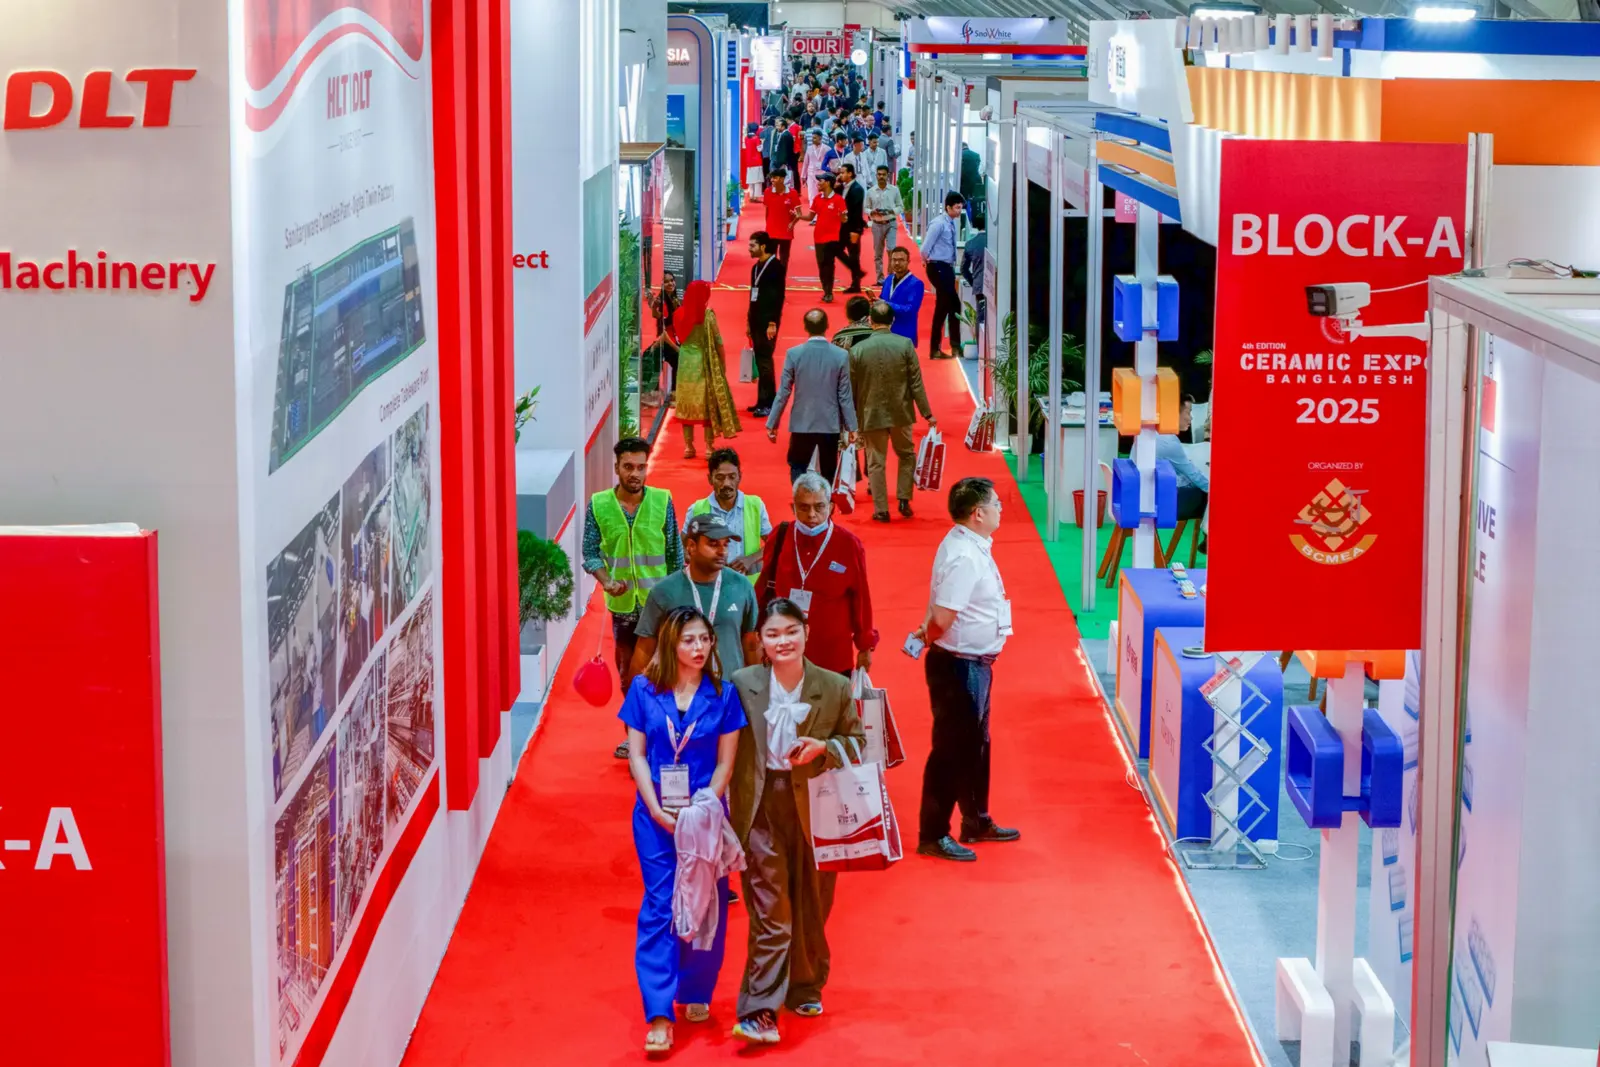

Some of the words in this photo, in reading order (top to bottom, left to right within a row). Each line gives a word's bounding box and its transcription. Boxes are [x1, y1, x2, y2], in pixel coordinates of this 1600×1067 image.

[667, 48, 690, 61] SIA
[794, 40, 838, 53] OUR
[4, 69, 197, 129] DLT
[327, 74, 348, 120] HLT
[353, 70, 372, 112] DLT
[1232, 213, 1462, 258] BLOCK-A
[512, 250, 549, 269] ect
[1242, 342, 1254, 350] 4th
[1256, 342, 1286, 350] EDITION
[1266, 374, 1413, 385] BANGLADESH
[1296, 398, 1380, 424] 2025
[1308, 462, 1353, 470] ORGANIZED
[1354, 462, 1364, 470] BY
[1302, 544, 1364, 563] BCMEA
[0, 806, 93, 871] -A
